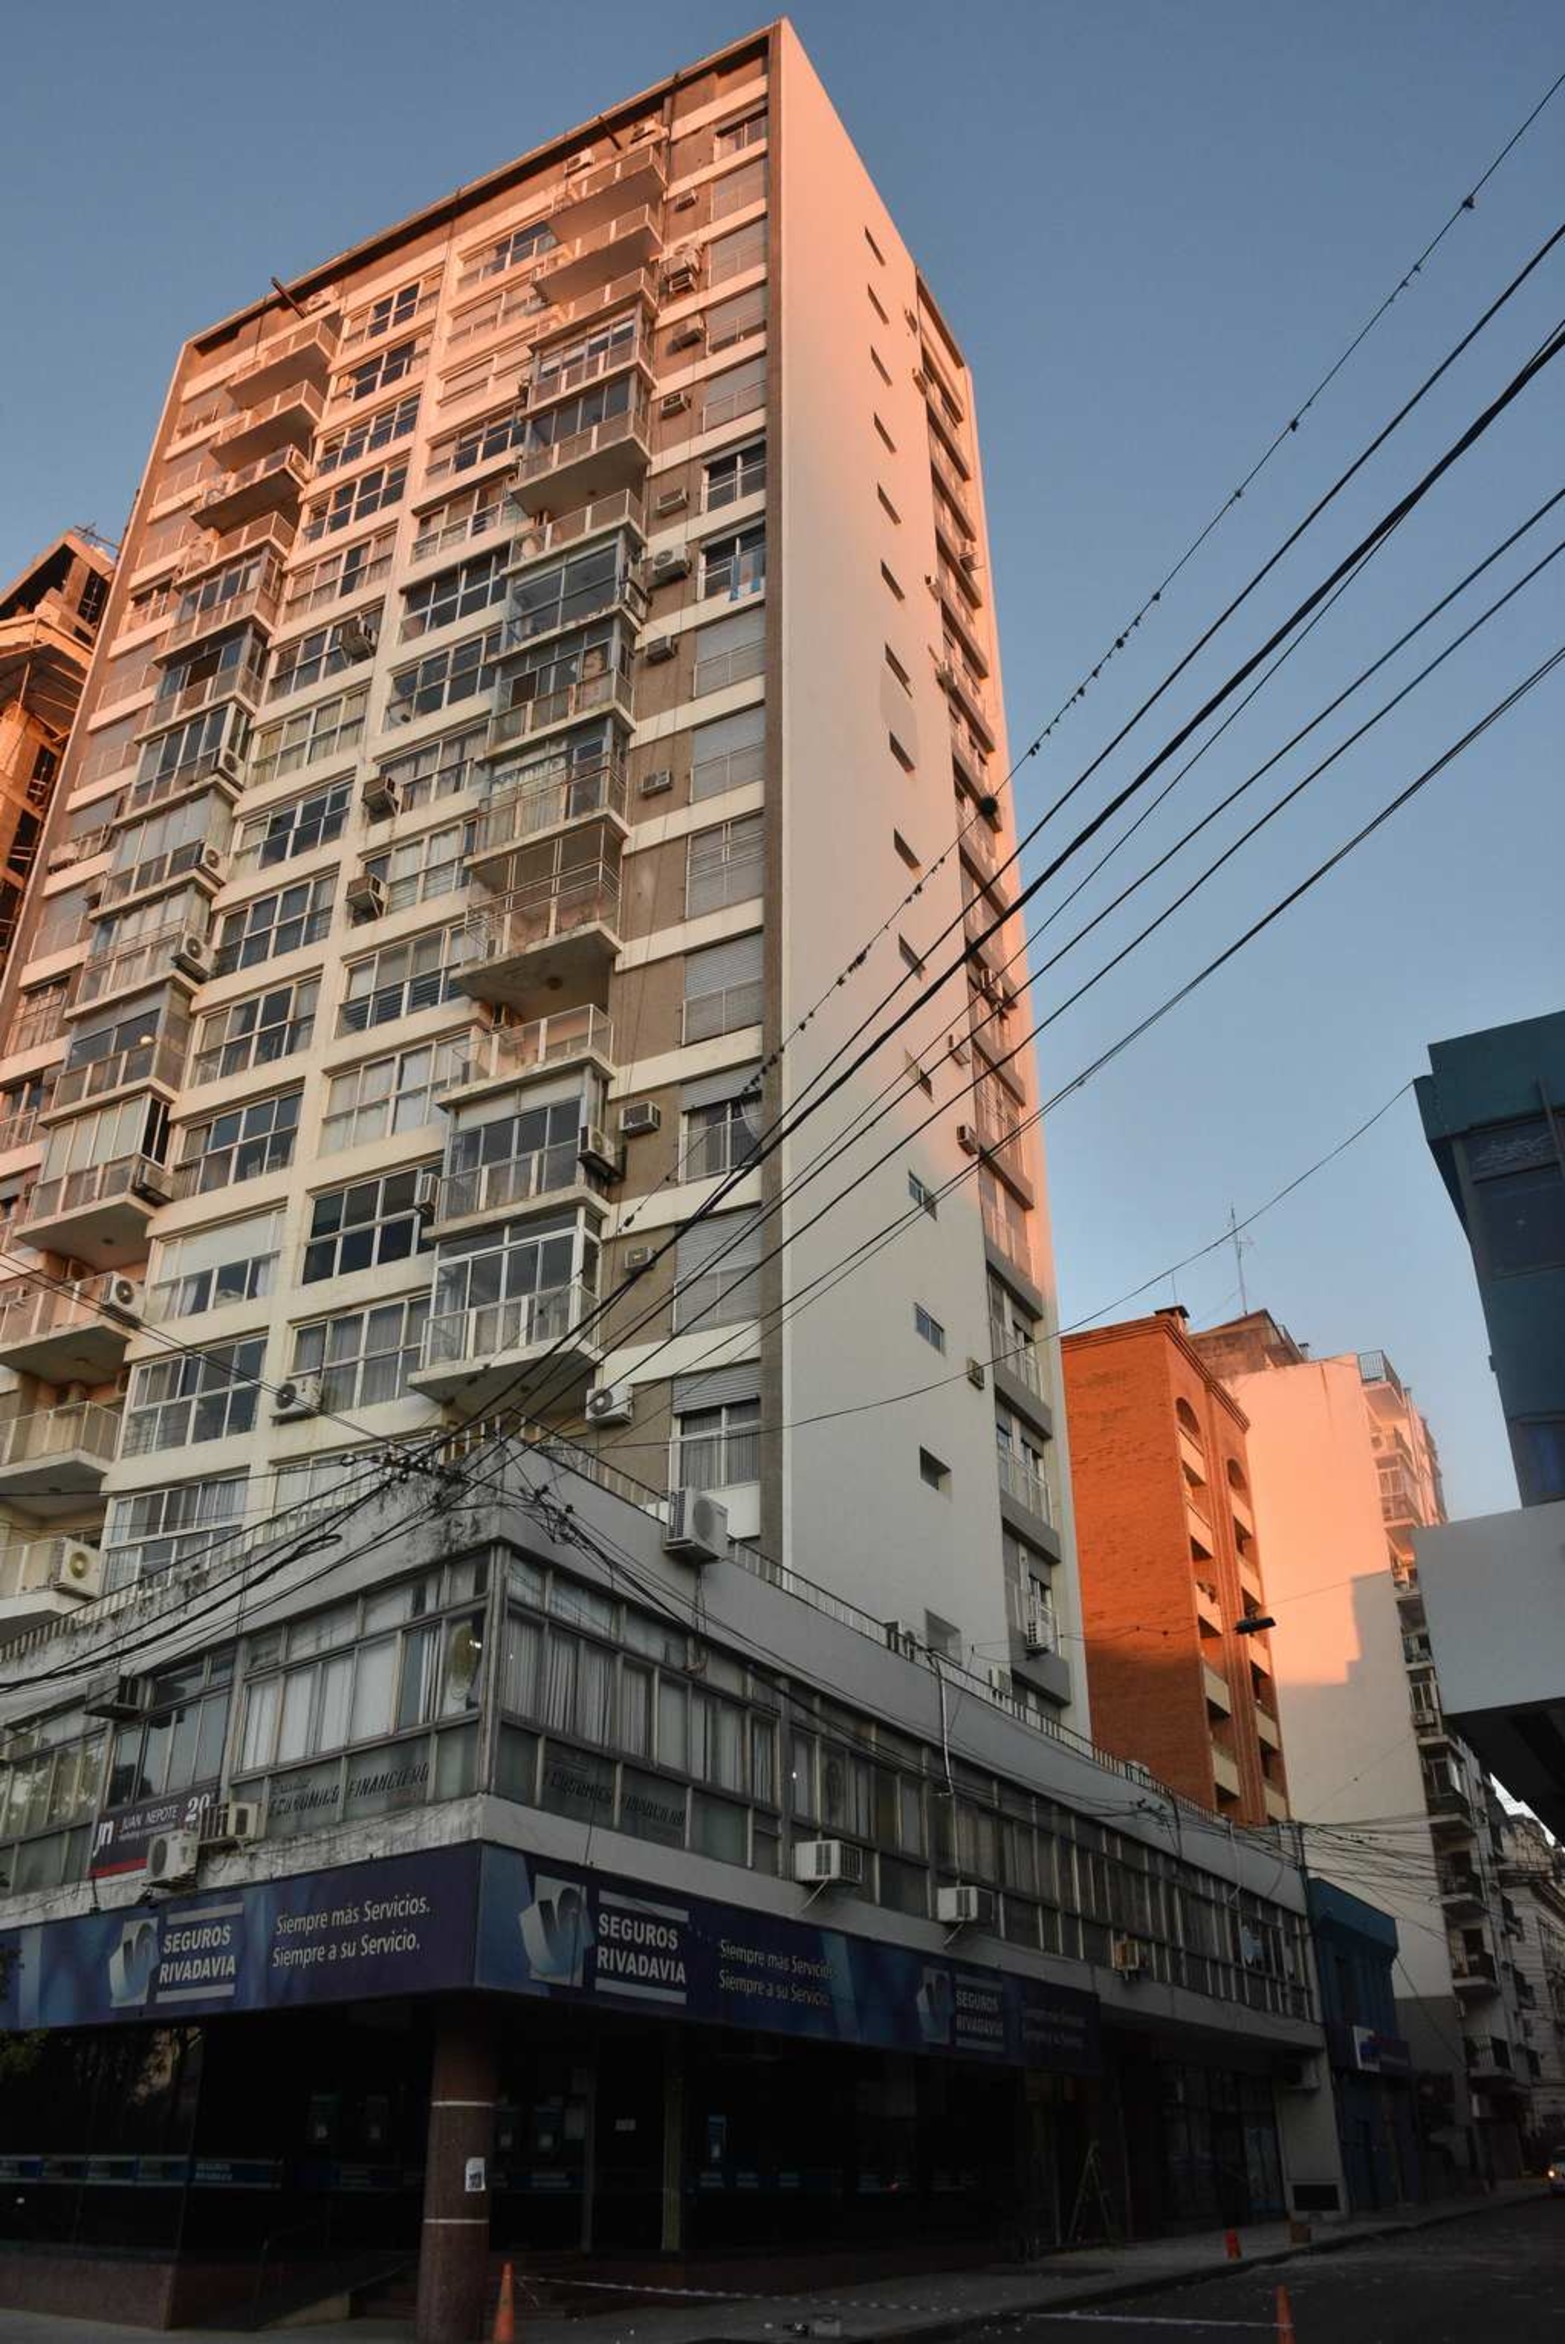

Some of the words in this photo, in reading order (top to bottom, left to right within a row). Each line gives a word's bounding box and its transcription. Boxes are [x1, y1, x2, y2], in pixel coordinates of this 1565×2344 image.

[146, 1804, 180, 1824] NEPOTE
[275, 1911, 328, 1937] Siempre
[363, 1893, 431, 1922] Servicios.
[162, 1924, 232, 1954] SEGUROS
[598, 1912, 680, 1951] SEGUROS
[272, 1945, 325, 1969] Siempre
[327, 1943, 338, 1961] a
[340, 1940, 357, 1959] su
[360, 1928, 421, 1957] Servicio.
[719, 1938, 765, 1969] Siempre
[158, 1955, 236, 1985] RIVADAVIA
[597, 1945, 687, 1985] RIVADAVIA
[718, 1968, 765, 1998] Siempre
[765, 1982, 775, 1999] a
[776, 1982, 789, 2000] su
[955, 1989, 999, 2012] SEGUROS
